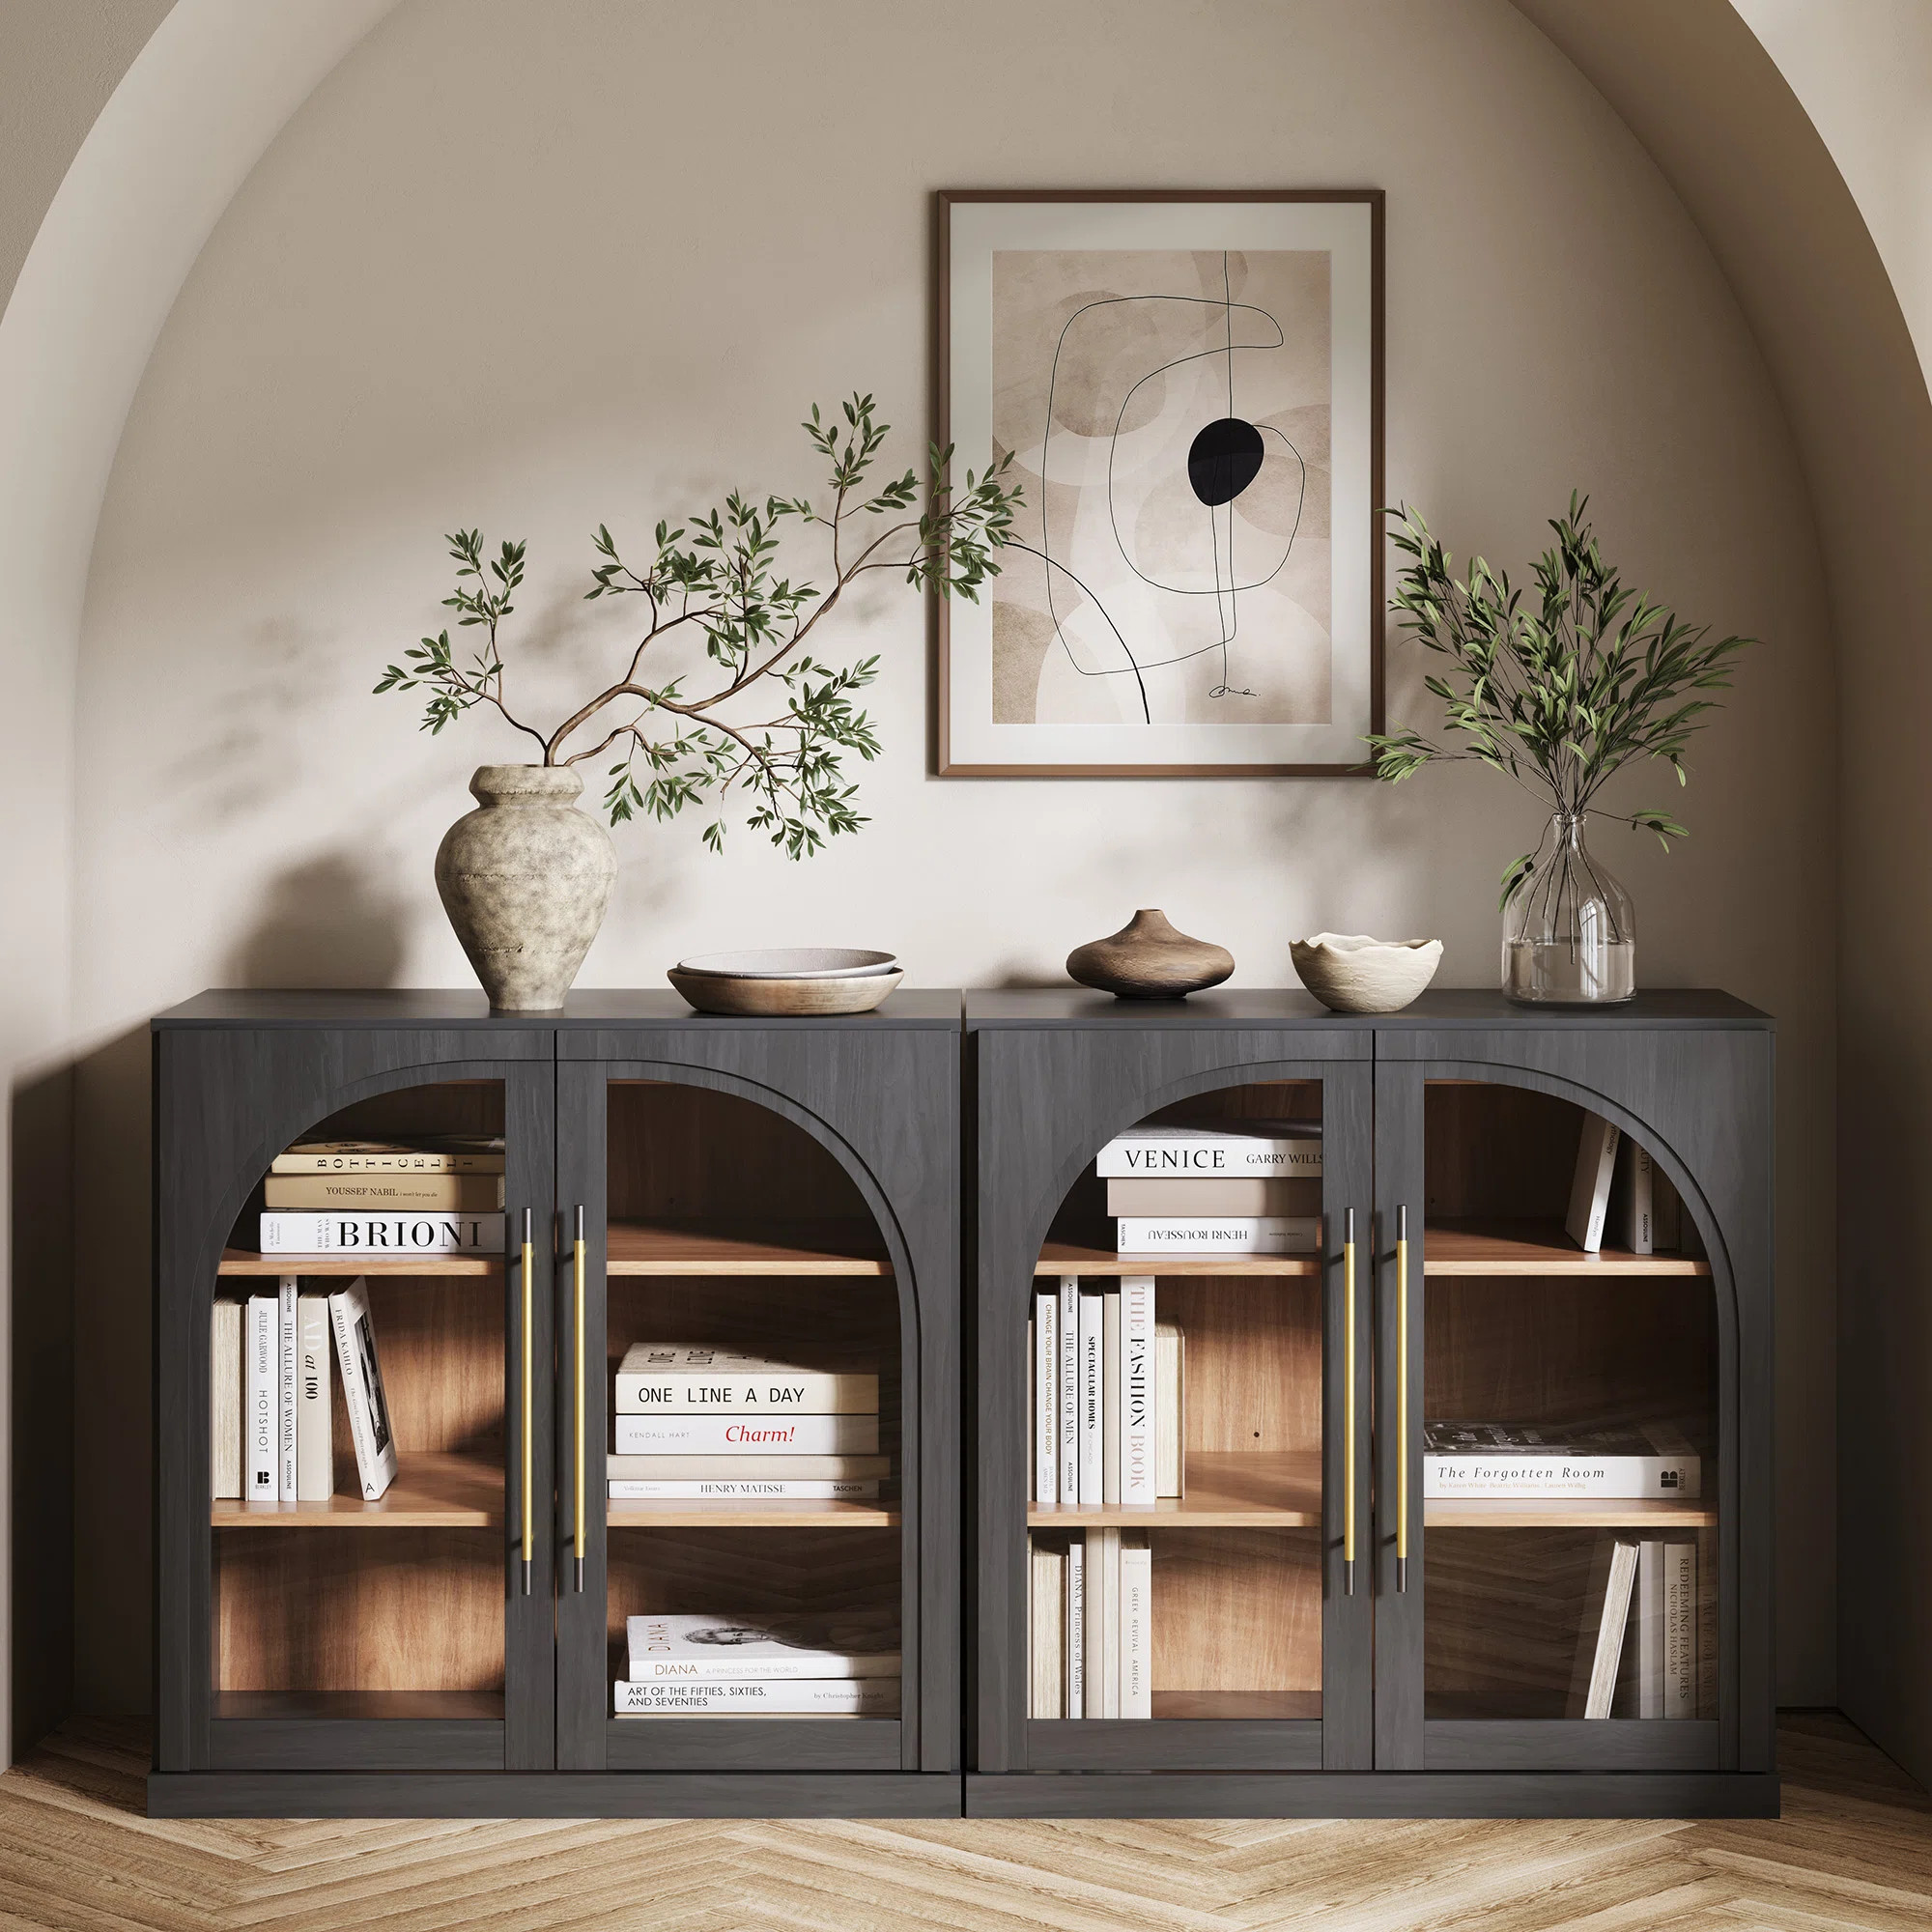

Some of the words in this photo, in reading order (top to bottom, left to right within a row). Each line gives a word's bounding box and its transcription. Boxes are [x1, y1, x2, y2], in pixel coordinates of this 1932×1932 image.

[317, 1158, 472, 1169] BOTTICELLI
[1124, 1150, 1226, 1169] VENICE
[1246, 1153, 1285, 1164] GARRY
[326, 1187, 368, 1196] YOUSSEF
[370, 1188, 398, 1197] NABIL
[337, 1221, 482, 1247] BRIONI
[1148, 1230, 1208, 1240] ROUSSEAU
[1211, 1230, 1248, 1240] HENRI
[1130, 1287, 1145, 1331] THE
[258, 1311, 268, 1334] JULIE
[284, 1321, 293, 1344] THE
[334, 1309, 346, 1339] FRIDA
[341, 1341, 352, 1376] KAHLO
[1065, 1332, 1074, 1354] THE
[258, 1335, 268, 1374] GARWOOD
[304, 1354, 316, 1370] at
[284, 1345, 293, 1389] ALLURE
[1065, 1355, 1074, 1400] ALLURE
[1130, 1338, 1145, 1428] FASHION
[304, 1376, 318, 1400] 100
[639, 1387, 672, 1403] ONE
[688, 1387, 732, 1403] LINE
[745, 1387, 756, 1403] A
[769, 1387, 805, 1403] DAY
[284, 1391, 293, 1406] OF
[1065, 1404, 1074, 1417] OF
[259, 1390, 268, 1453] HOTSHOT
[284, 1408, 293, 1452] WOMEN
[725, 1425, 795, 1442] Charm!
[1065, 1420, 1074, 1444] MEN
[1130, 1435, 1145, 1489] BOOK
[1438, 1467, 1465, 1478] The
[1474, 1467, 1553, 1481] Forgotten
[1562, 1467, 1605, 1478] Room
[700, 1484, 736, 1493] HENRY
[740, 1484, 786, 1493] MATISSE
[1680, 1558, 1690, 1633] REDEEMING
[648, 1623, 670, 1652] DIANA
[1075, 1652, 1082, 1662] of
[655, 1664, 697, 1676] DIANA
[1680, 1636, 1690, 1699] FEATURES
[628, 1688, 646, 1696] ART
[651, 1688, 666, 1696] OF
[668, 1688, 688, 1696] THE
[691, 1688, 725, 1697] FIFTIES,
[729, 1687, 766, 1697] SIXTIES,
[628, 1697, 652, 1706] AND
[655, 1697, 708, 1706] SEVENTIES
[862, 1692, 884, 1701] Knight
